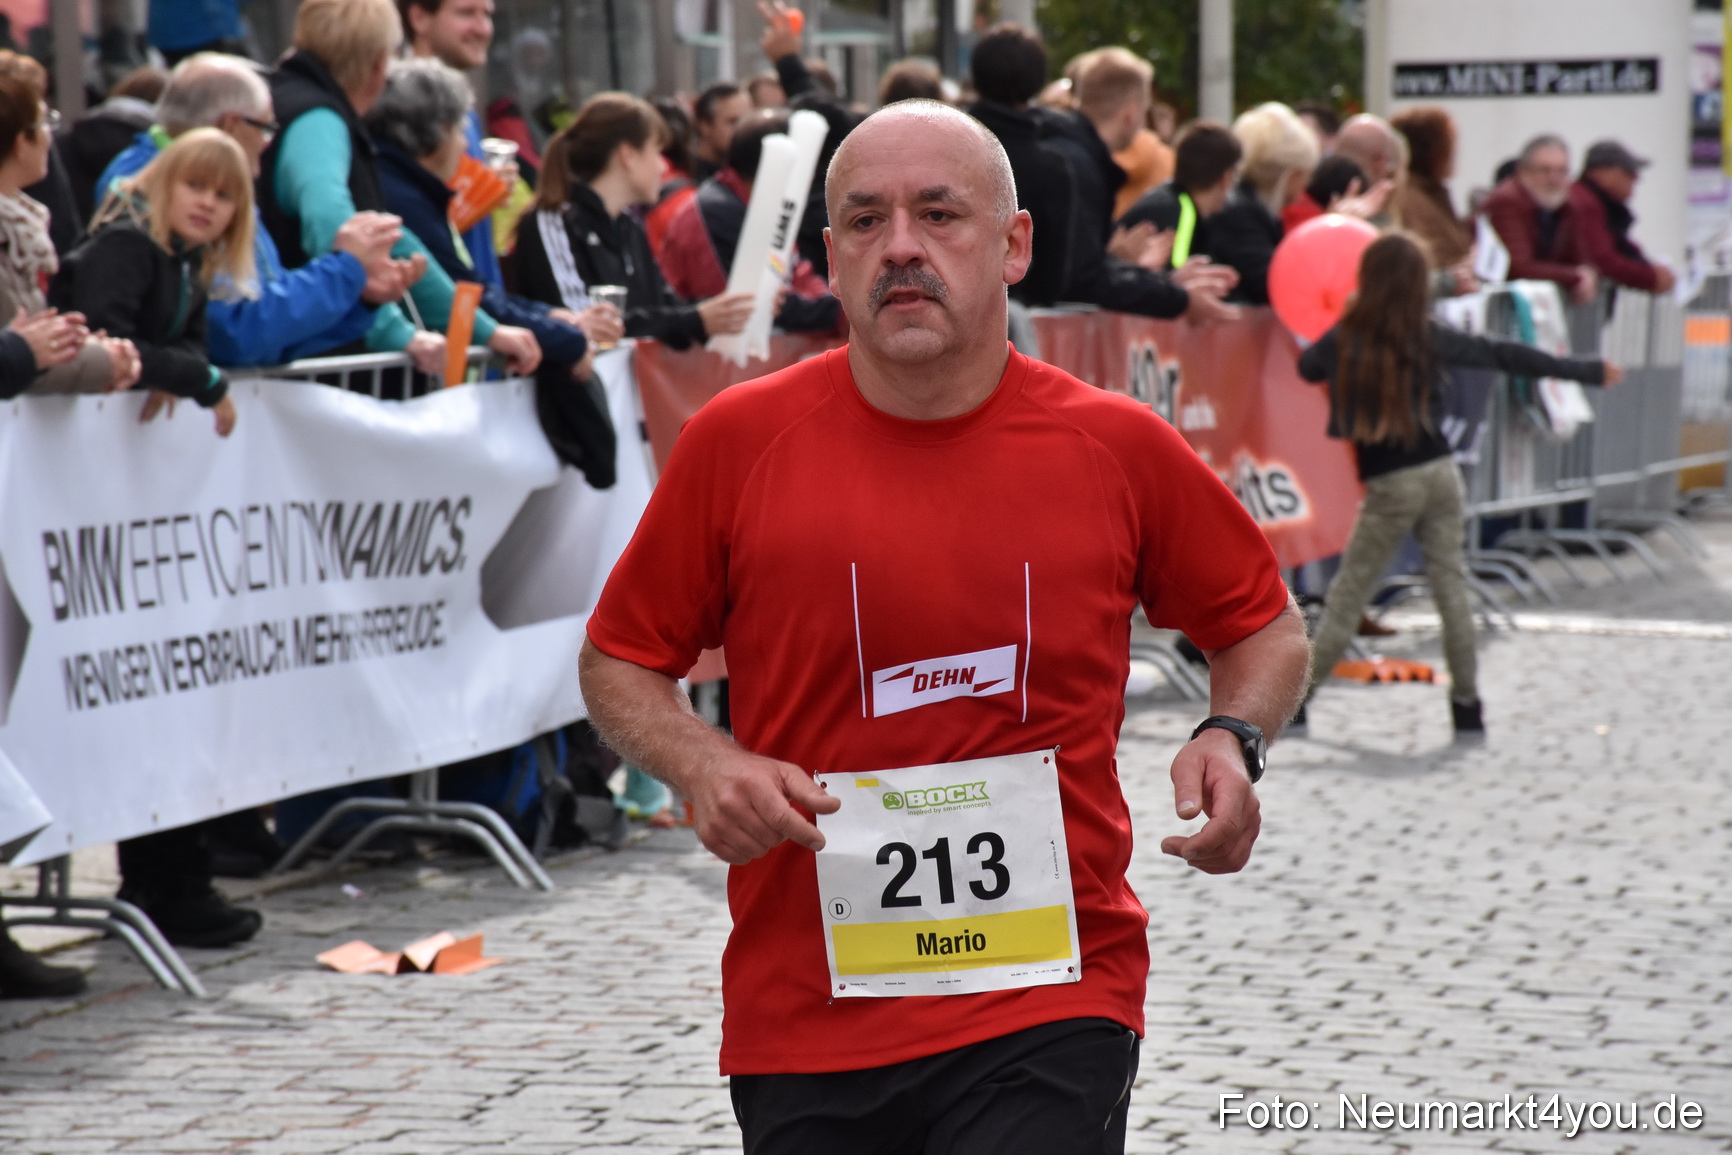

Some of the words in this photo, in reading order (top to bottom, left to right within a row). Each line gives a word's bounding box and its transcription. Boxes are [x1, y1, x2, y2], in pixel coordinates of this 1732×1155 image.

[42, 524, 124, 621] BMW
[130, 495, 472, 609] EFFICIENTYNAMICS.
[913, 667, 976, 693] DEHN
[904, 781, 989, 809] BOCK
[907, 808, 932, 816] inspired
[942, 804, 962, 812] smart
[962, 801, 992, 809] concepts
[876, 832, 1011, 909] 213
[835, 903, 845, 915] D
[916, 929, 986, 956] Mario
